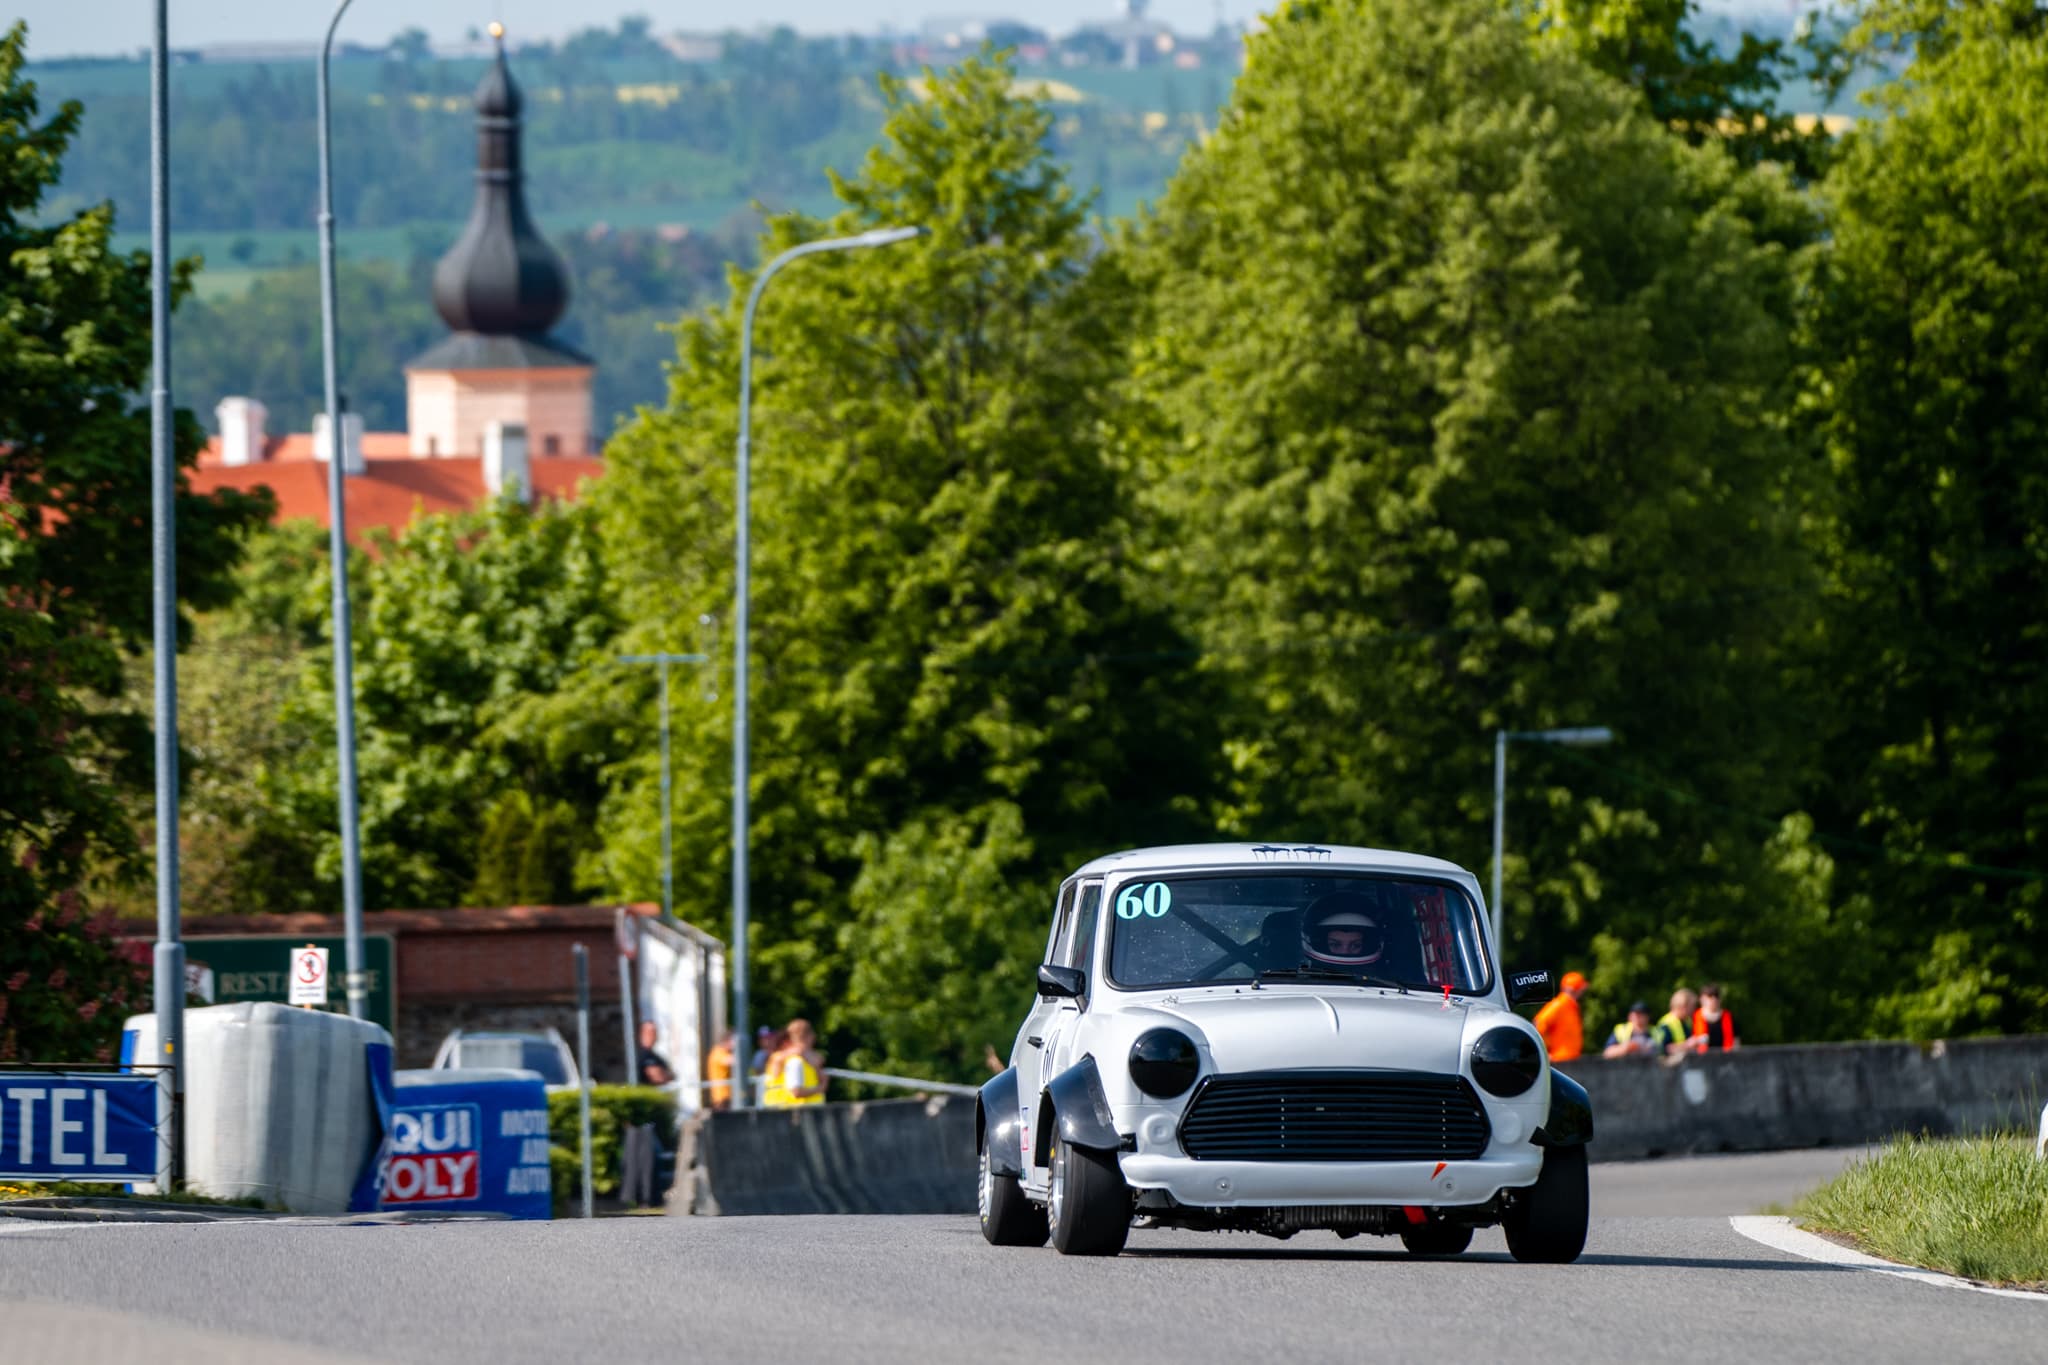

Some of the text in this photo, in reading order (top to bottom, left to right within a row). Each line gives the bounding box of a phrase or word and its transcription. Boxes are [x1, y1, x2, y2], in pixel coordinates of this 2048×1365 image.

[1116, 881, 1172, 919] 60
[1515, 971, 1549, 986] unicef
[0, 1087, 127, 1166] TEL
[391, 1109, 471, 1154] QUI
